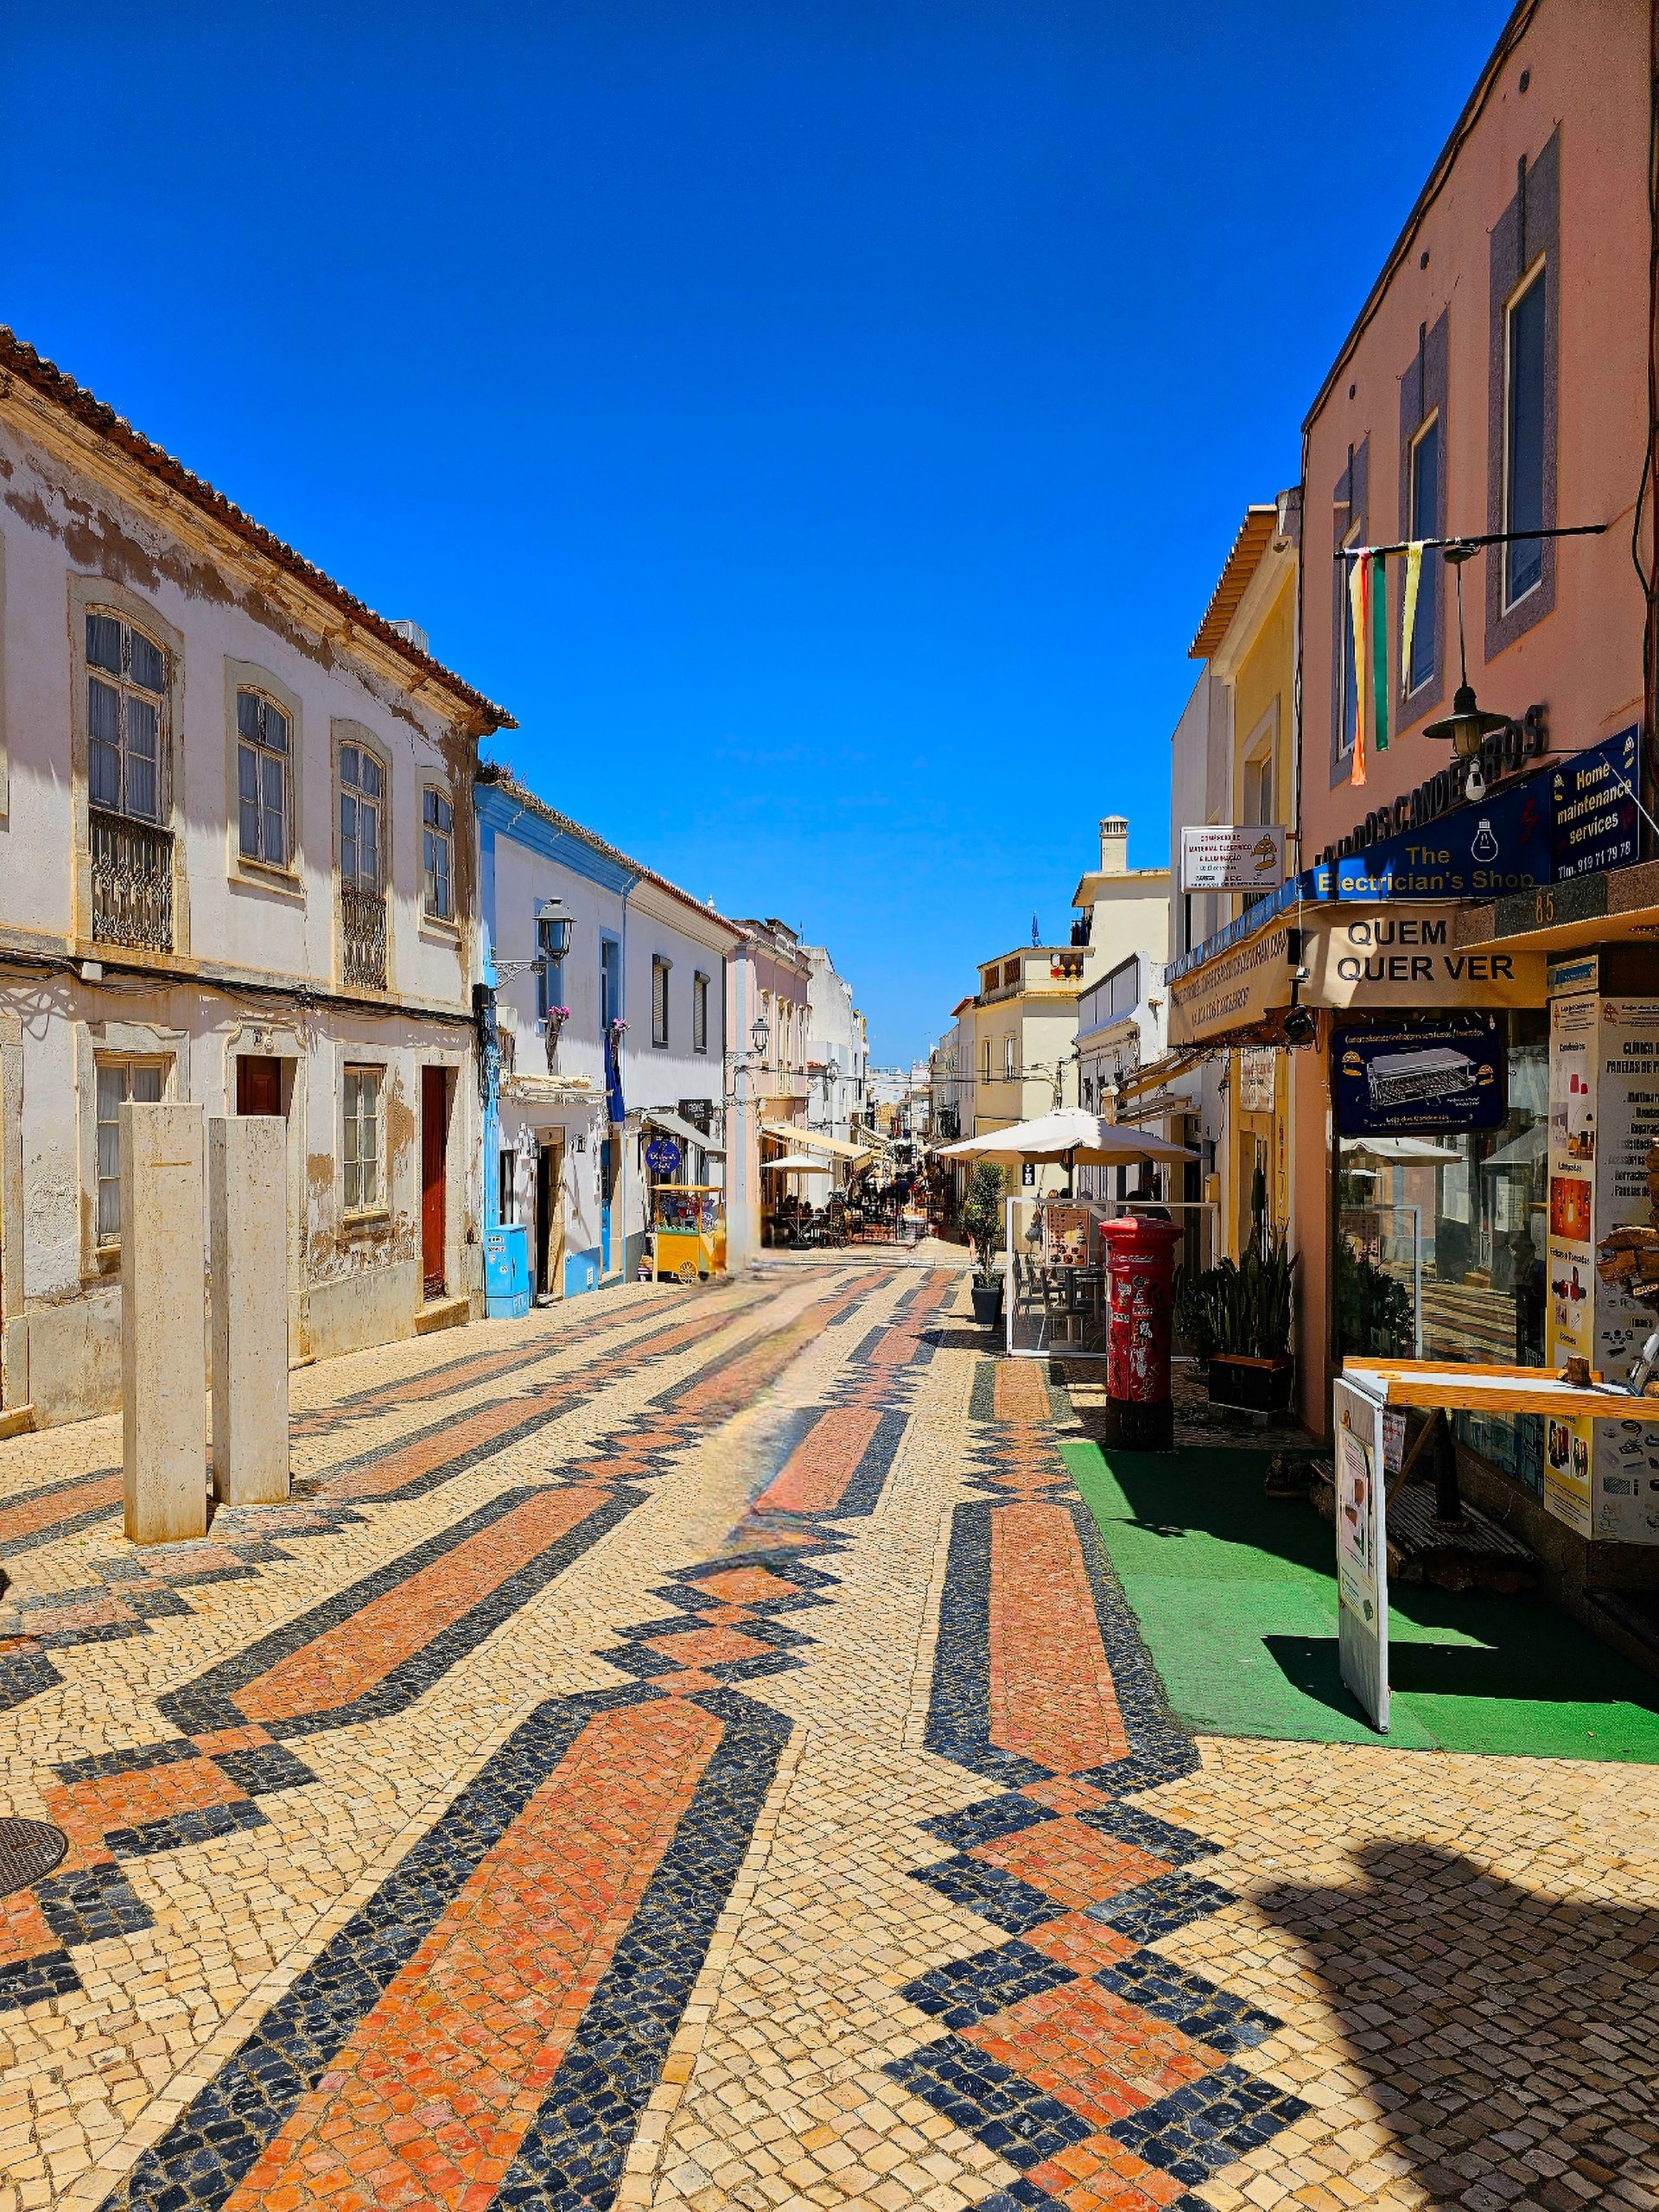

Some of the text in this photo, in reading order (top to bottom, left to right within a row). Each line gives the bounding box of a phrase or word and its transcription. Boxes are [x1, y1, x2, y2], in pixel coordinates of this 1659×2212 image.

[1395, 705, 1548, 832] CANDEROS
[1577, 763, 1610, 790] Home
[1557, 779, 1632, 825] maintenance
[1570, 812, 1618, 845] services
[1405, 846, 1451, 864] The
[1578, 856, 1593, 874] 919
[1319, 870, 1535, 891] Electrician's Shop
[1536, 894, 1553, 924] 85
[1348, 920, 1446, 945] QUEM
[1338, 955, 1515, 982] QUER VER
